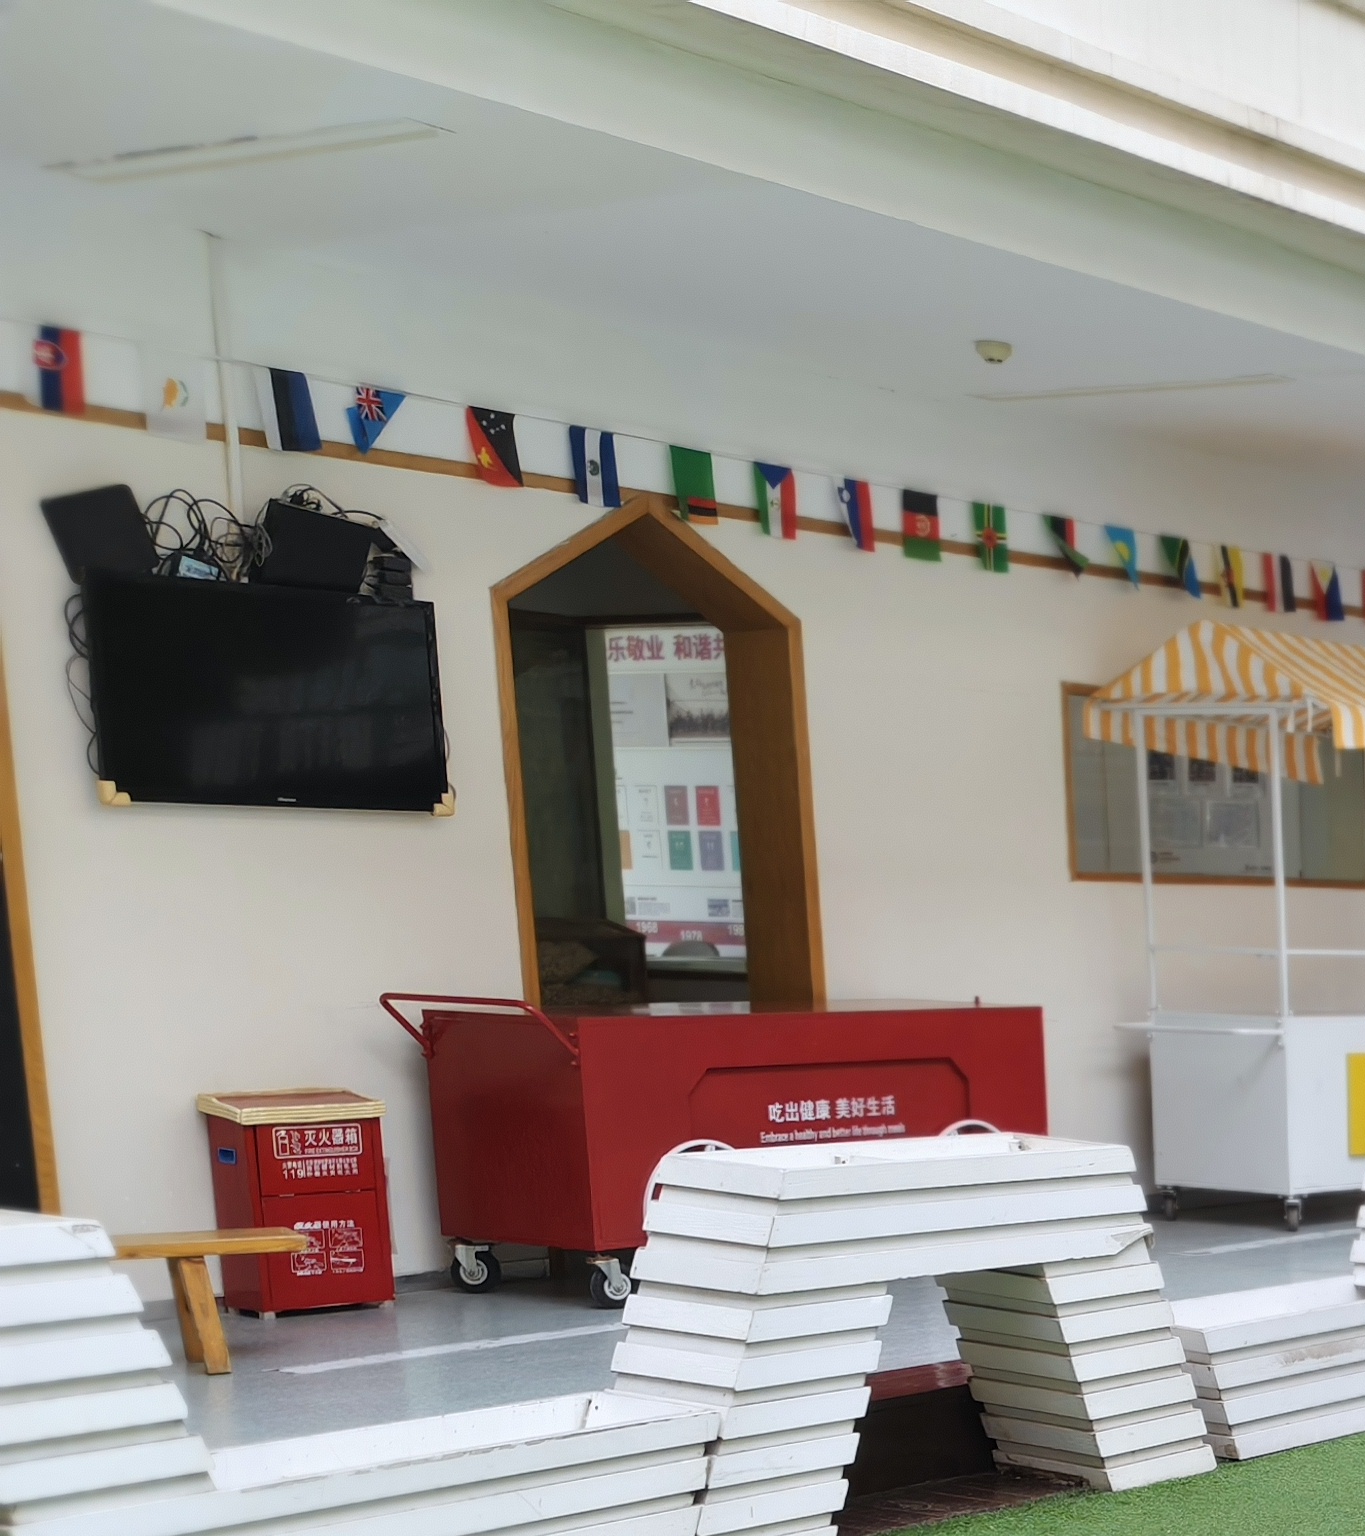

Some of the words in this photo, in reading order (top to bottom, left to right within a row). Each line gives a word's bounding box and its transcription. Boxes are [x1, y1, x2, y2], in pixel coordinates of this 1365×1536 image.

[768, 1099, 831, 1123] 吃出健康
[835, 1095, 896, 1119] 美好生活
[304, 1127, 358, 1147] 灭火器箱
[282, 1168, 304, 1180] 119
